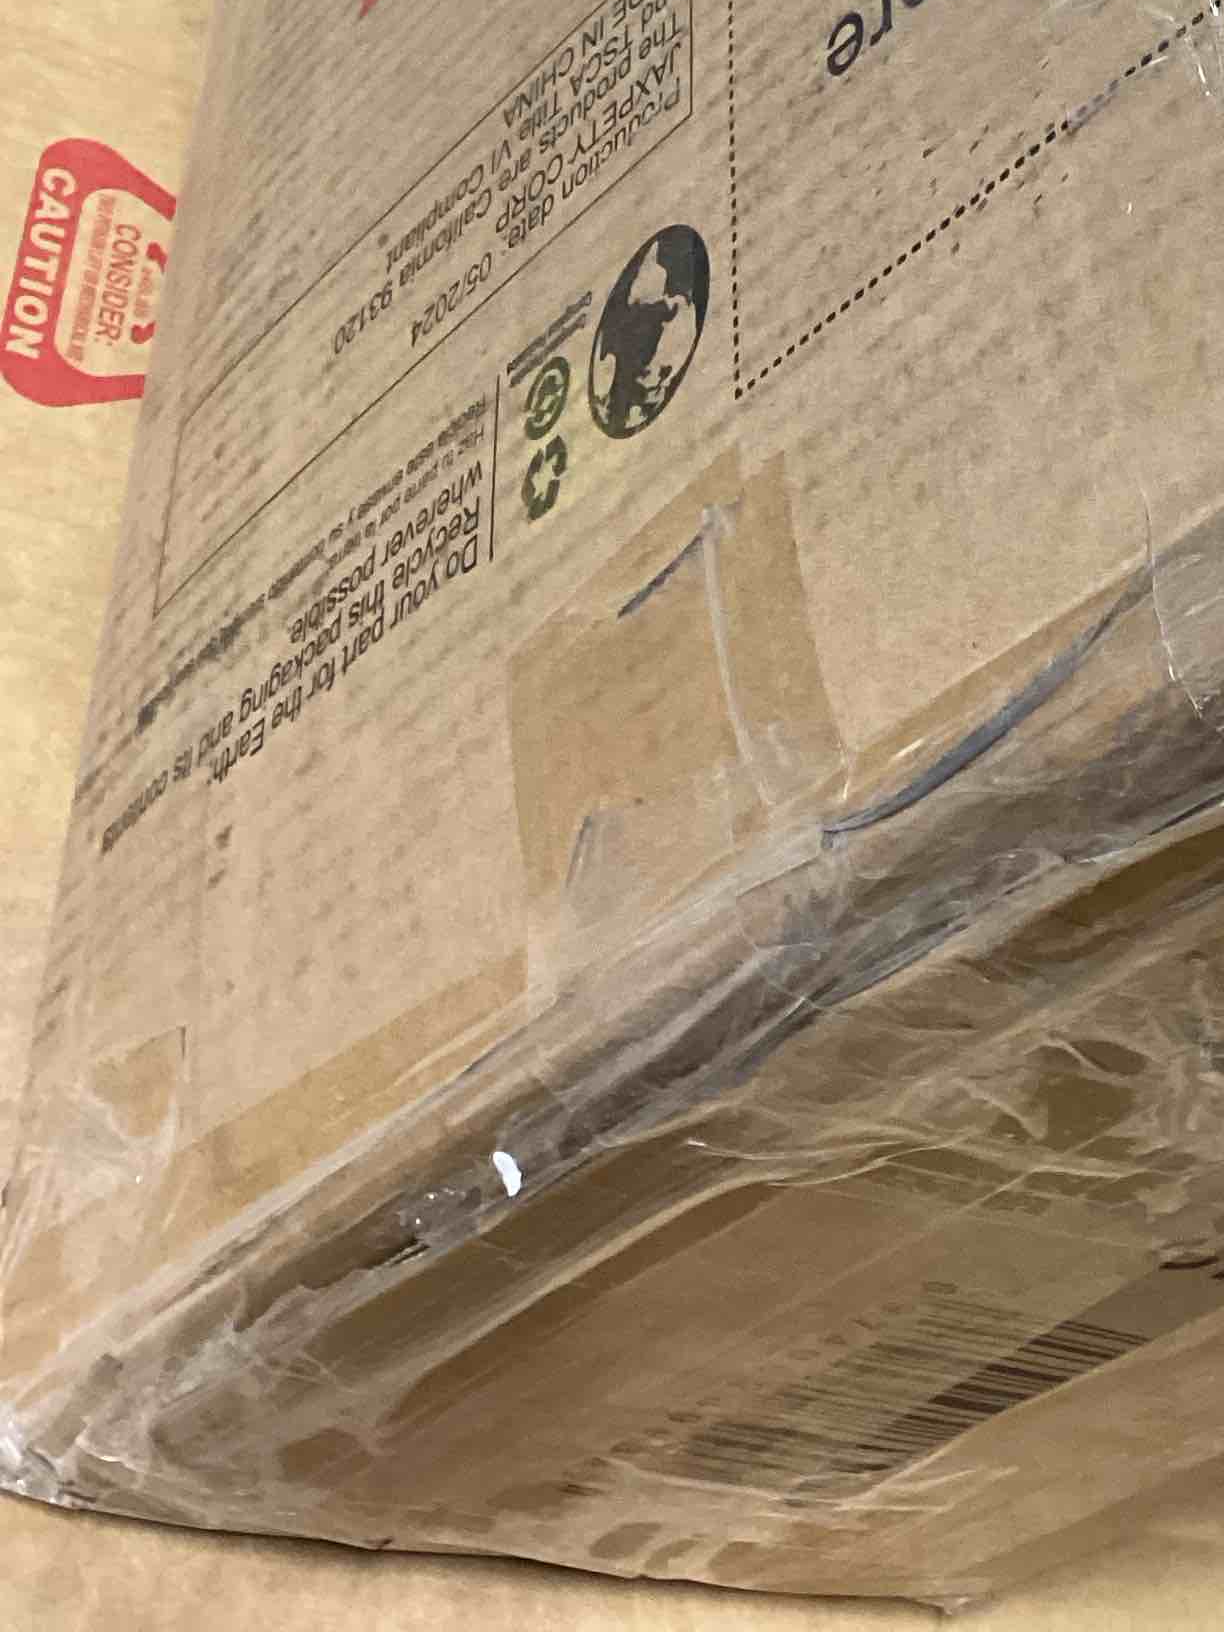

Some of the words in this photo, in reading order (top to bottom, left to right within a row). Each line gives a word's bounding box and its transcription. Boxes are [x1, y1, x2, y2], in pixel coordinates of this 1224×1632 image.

[569, 20, 632, 95] TSCA
[580, 17, 603, 55] IN
[637, 5, 681, 67] The
[503, 43, 573, 132] CHINA
[518, 89, 560, 146] Title
[538, 47, 631, 158] products
[566, 39, 679, 166] JAXPETY
[490, 133, 512, 175] VI
[497, 145, 532, 195] are
[560, 75, 681, 204] Production
[386, 159, 484, 275] Compliant
[494, 150, 563, 235] CORP
[500, 191, 553, 258] date:
[3, 164, 76, 360] CAUTION
[398, 183, 492, 293] California
[92, 221, 142, 347] CONSIDER:
[409, 249, 491, 349] 05/2024
[380, 457, 481, 572] wherever
[391, 493, 480, 595] Recycle
[443, 535, 479, 574] Do
[348, 577, 384, 635] this
[389, 566, 437, 629] your
[239, 610, 341, 728] packaging
[307, 655, 334, 701] for
[332, 609, 384, 682] part
[197, 708, 233, 767] and
[270, 684, 301, 737] the
